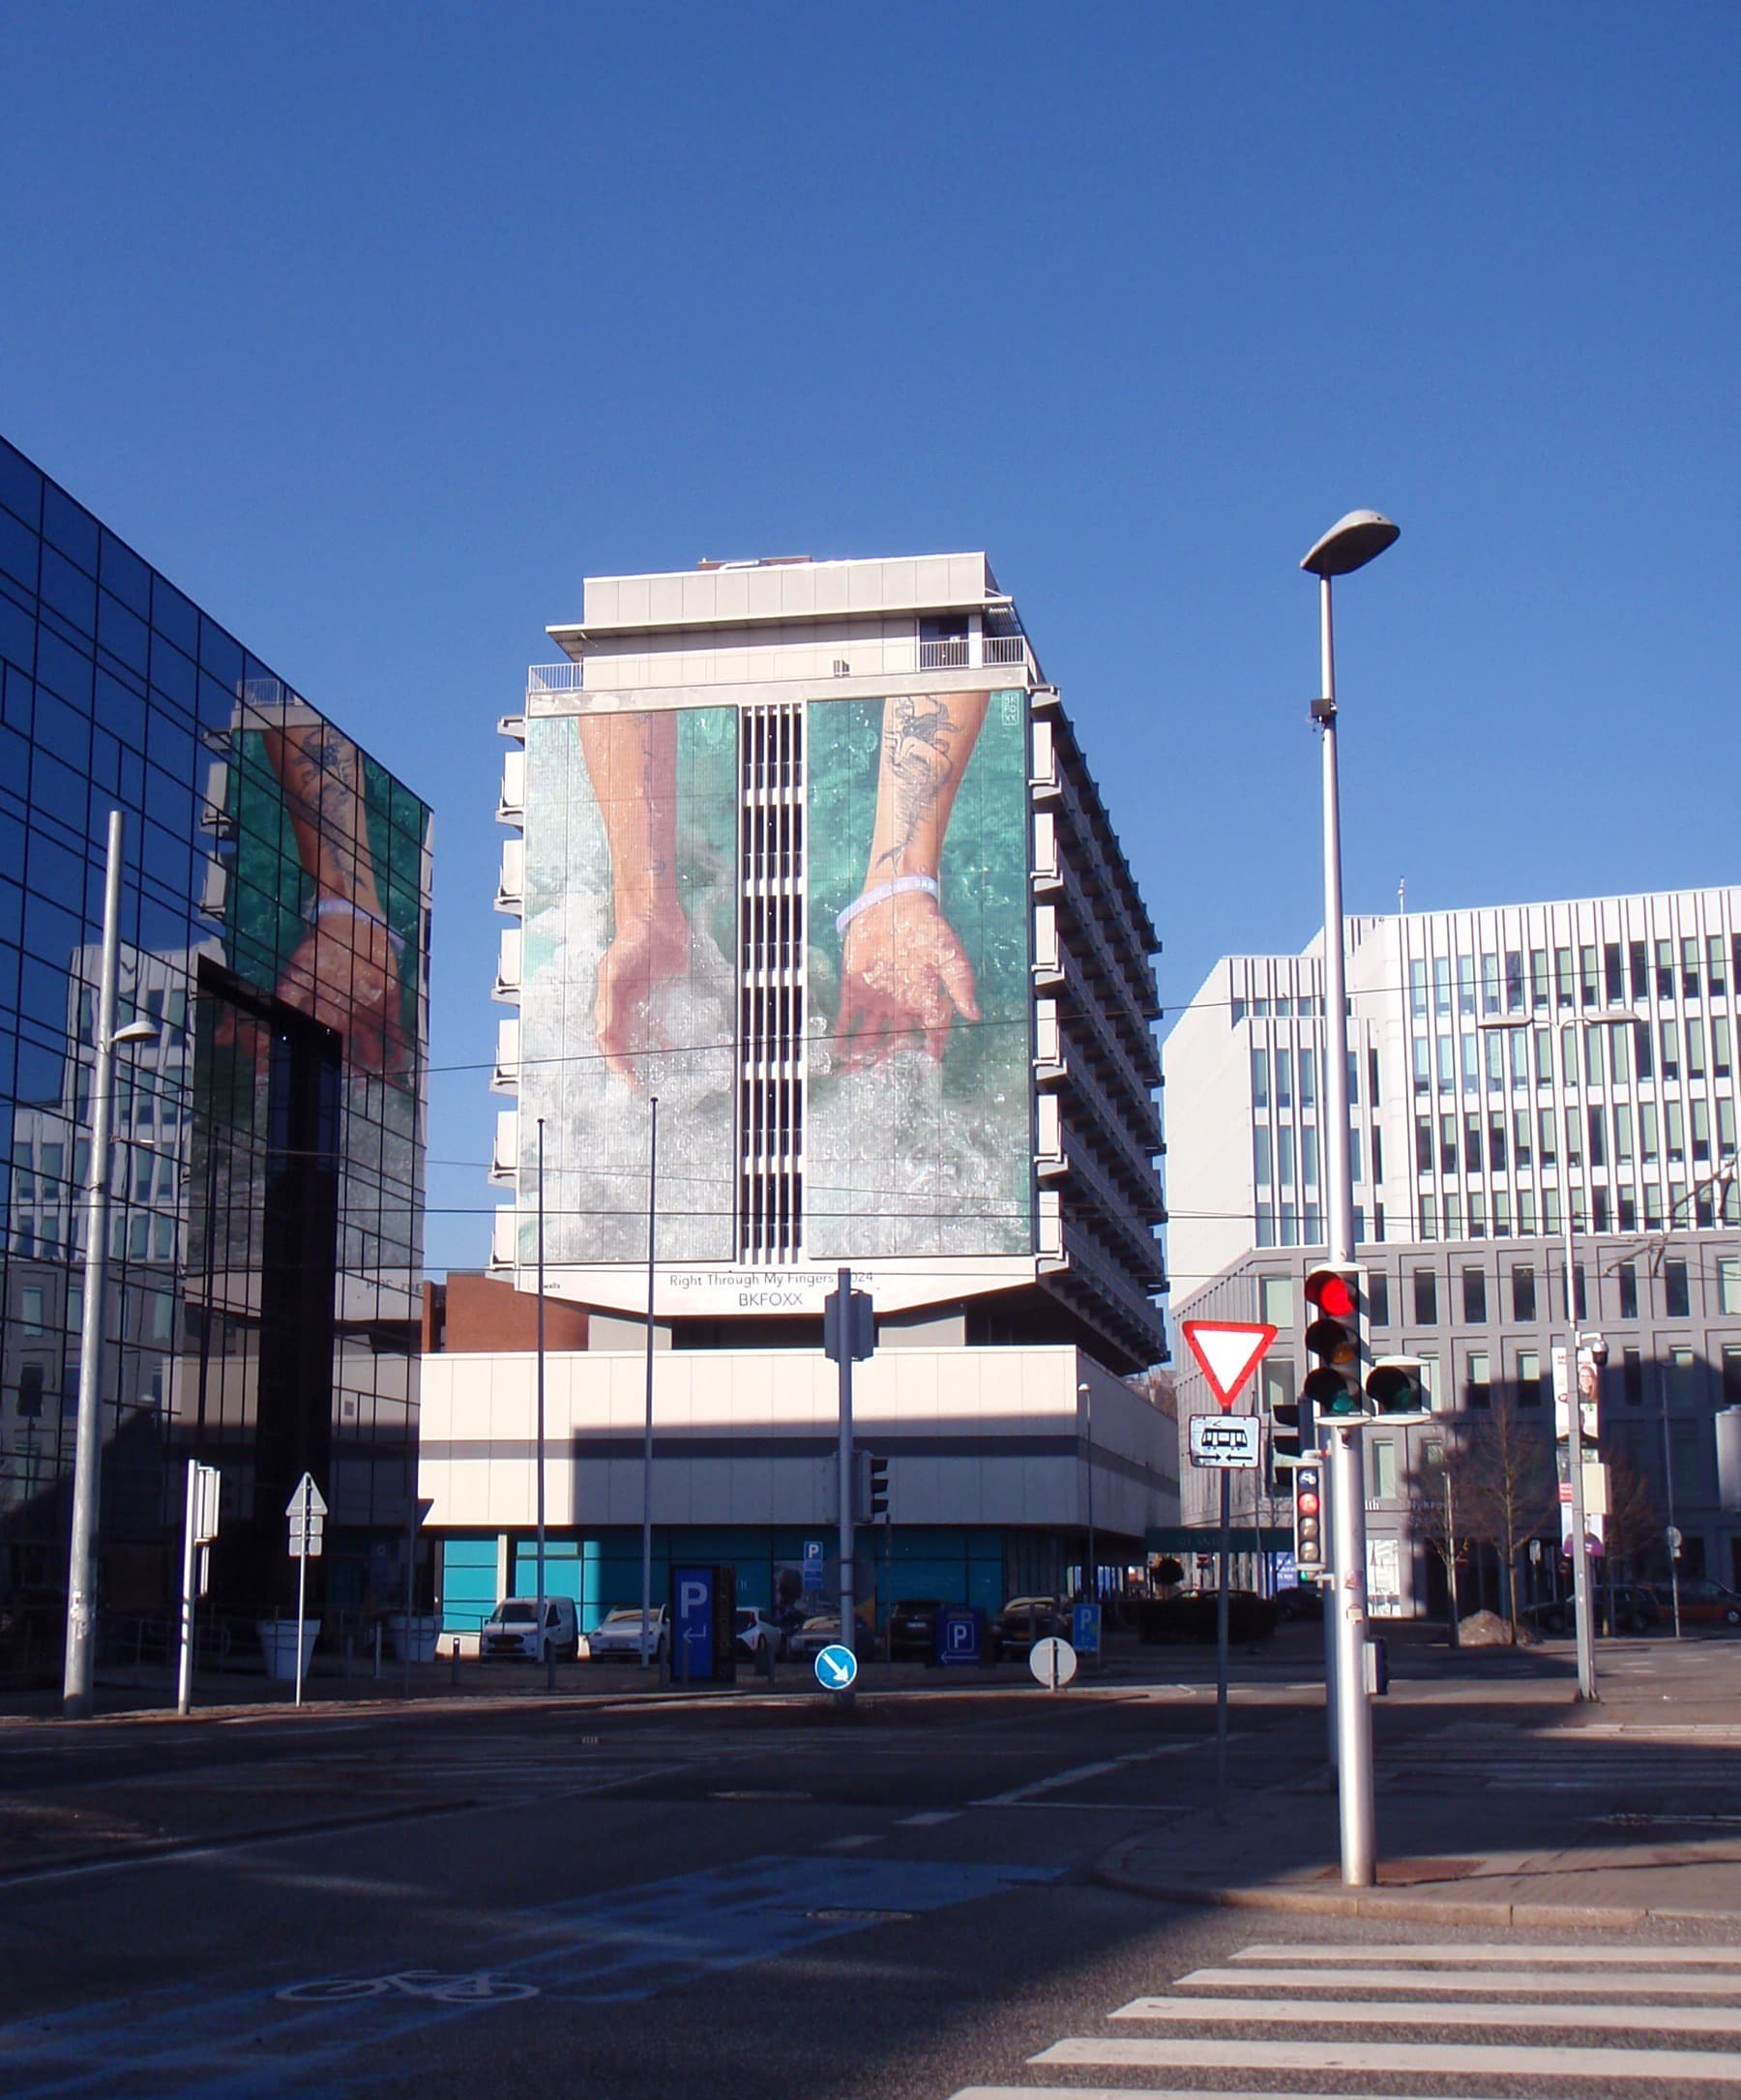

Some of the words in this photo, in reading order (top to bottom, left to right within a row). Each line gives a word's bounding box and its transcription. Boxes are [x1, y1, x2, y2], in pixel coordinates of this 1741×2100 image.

[669, 1274, 702, 1289] Right
[707, 1273, 759, 1288] Through
[764, 1273, 783, 1287] My
[850, 1272, 872, 1283] 024
[738, 1292, 804, 1307] BKFOXX
[808, 1544, 819, 1559] P
[680, 1581, 708, 1618] P
[1080, 1609, 1092, 1630] P
[953, 1624, 967, 1648] P
